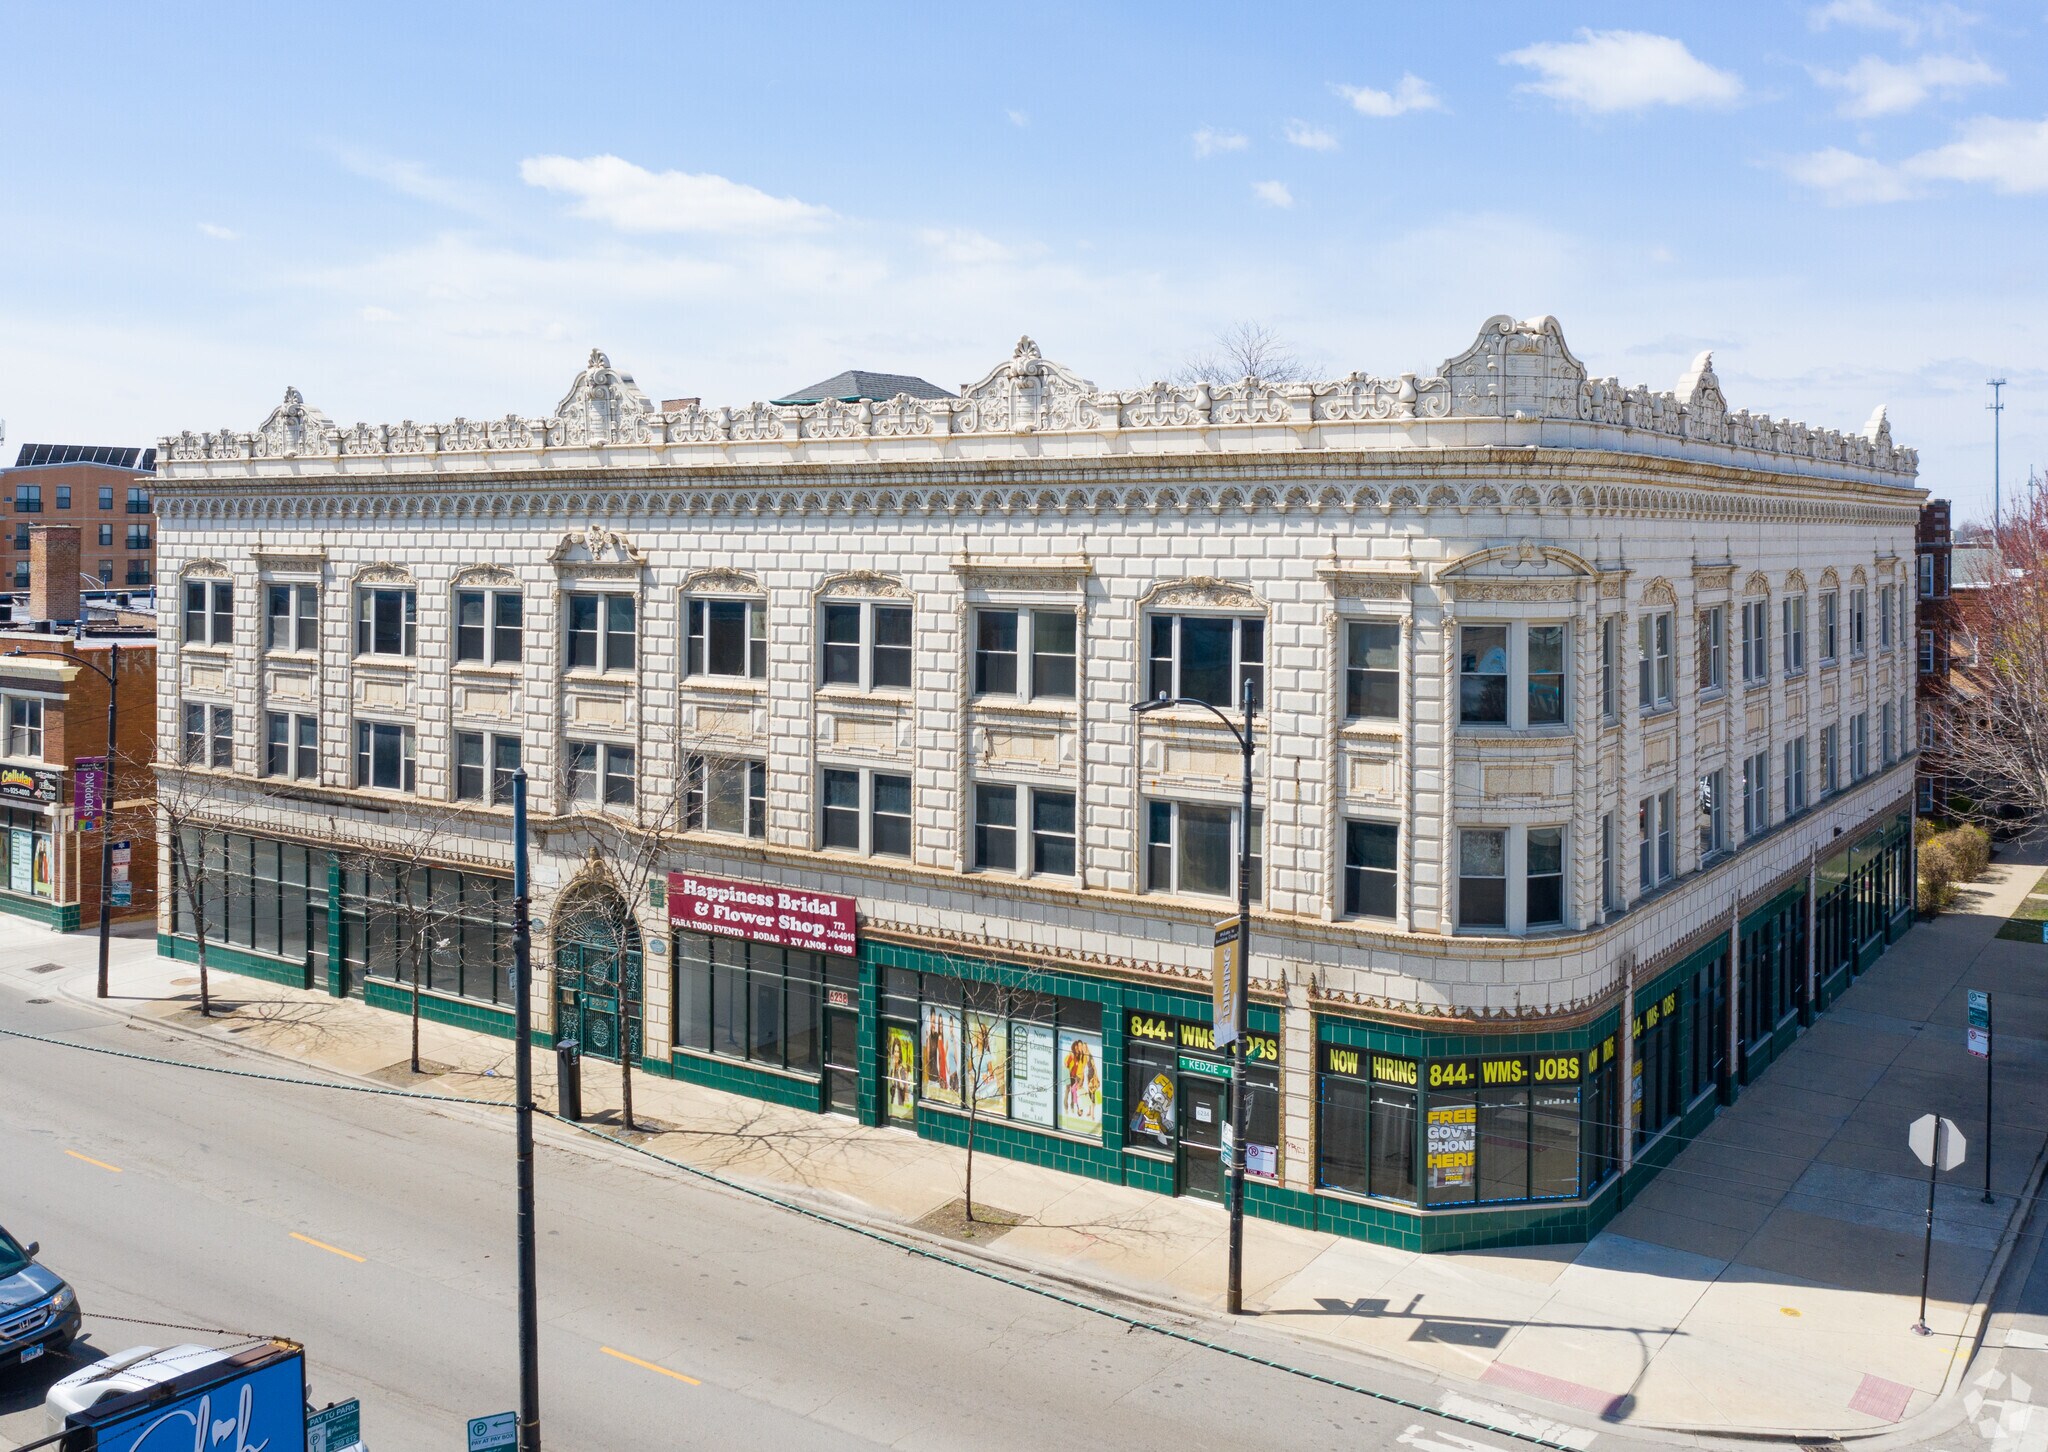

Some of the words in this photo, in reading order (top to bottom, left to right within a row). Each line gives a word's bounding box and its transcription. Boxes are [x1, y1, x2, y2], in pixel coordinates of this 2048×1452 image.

[1, 768, 33, 786] Cellular
[84, 772, 95, 817] SHOPPING
[683, 879, 774, 908] Happiness
[778, 893, 838, 917] Bridal
[694, 901, 710, 916] &
[713, 904, 775, 927] Flower
[779, 914, 825, 938] Shop
[833, 921, 846, 931] 773
[671, 917, 691, 928] PARA
[692, 920, 713, 932] TODO
[714, 924, 744, 937] EVENTO
[753, 931, 780, 943] BODAS
[791, 937, 803, 946] XV
[834, 943, 852, 954] 6238
[1223, 947, 1231, 1018] DINING
[830, 990, 848, 1004] 6238
[1131, 1015, 1174, 1041] 844-
[1189, 1059, 1219, 1075] KEDZIE
[1330, 1049, 1358, 1075] NOW
[1373, 1056, 1417, 1085] HIRING
[1429, 1063, 1475, 1087] 844-
[1483, 1060, 1528, 1083] WMS-
[1534, 1057, 1580, 1081] JOBS
[1428, 1109, 1477, 1125] FREE
[1428, 1125, 1476, 1139] GOV'T
[1428, 1140, 1476, 1153] PHONE
[1427, 1152, 1476, 1169] HERE
[310, 1415, 324, 1427] PAY
[324, 1411, 335, 1420] TO
[336, 1402, 356, 1416] PARK
